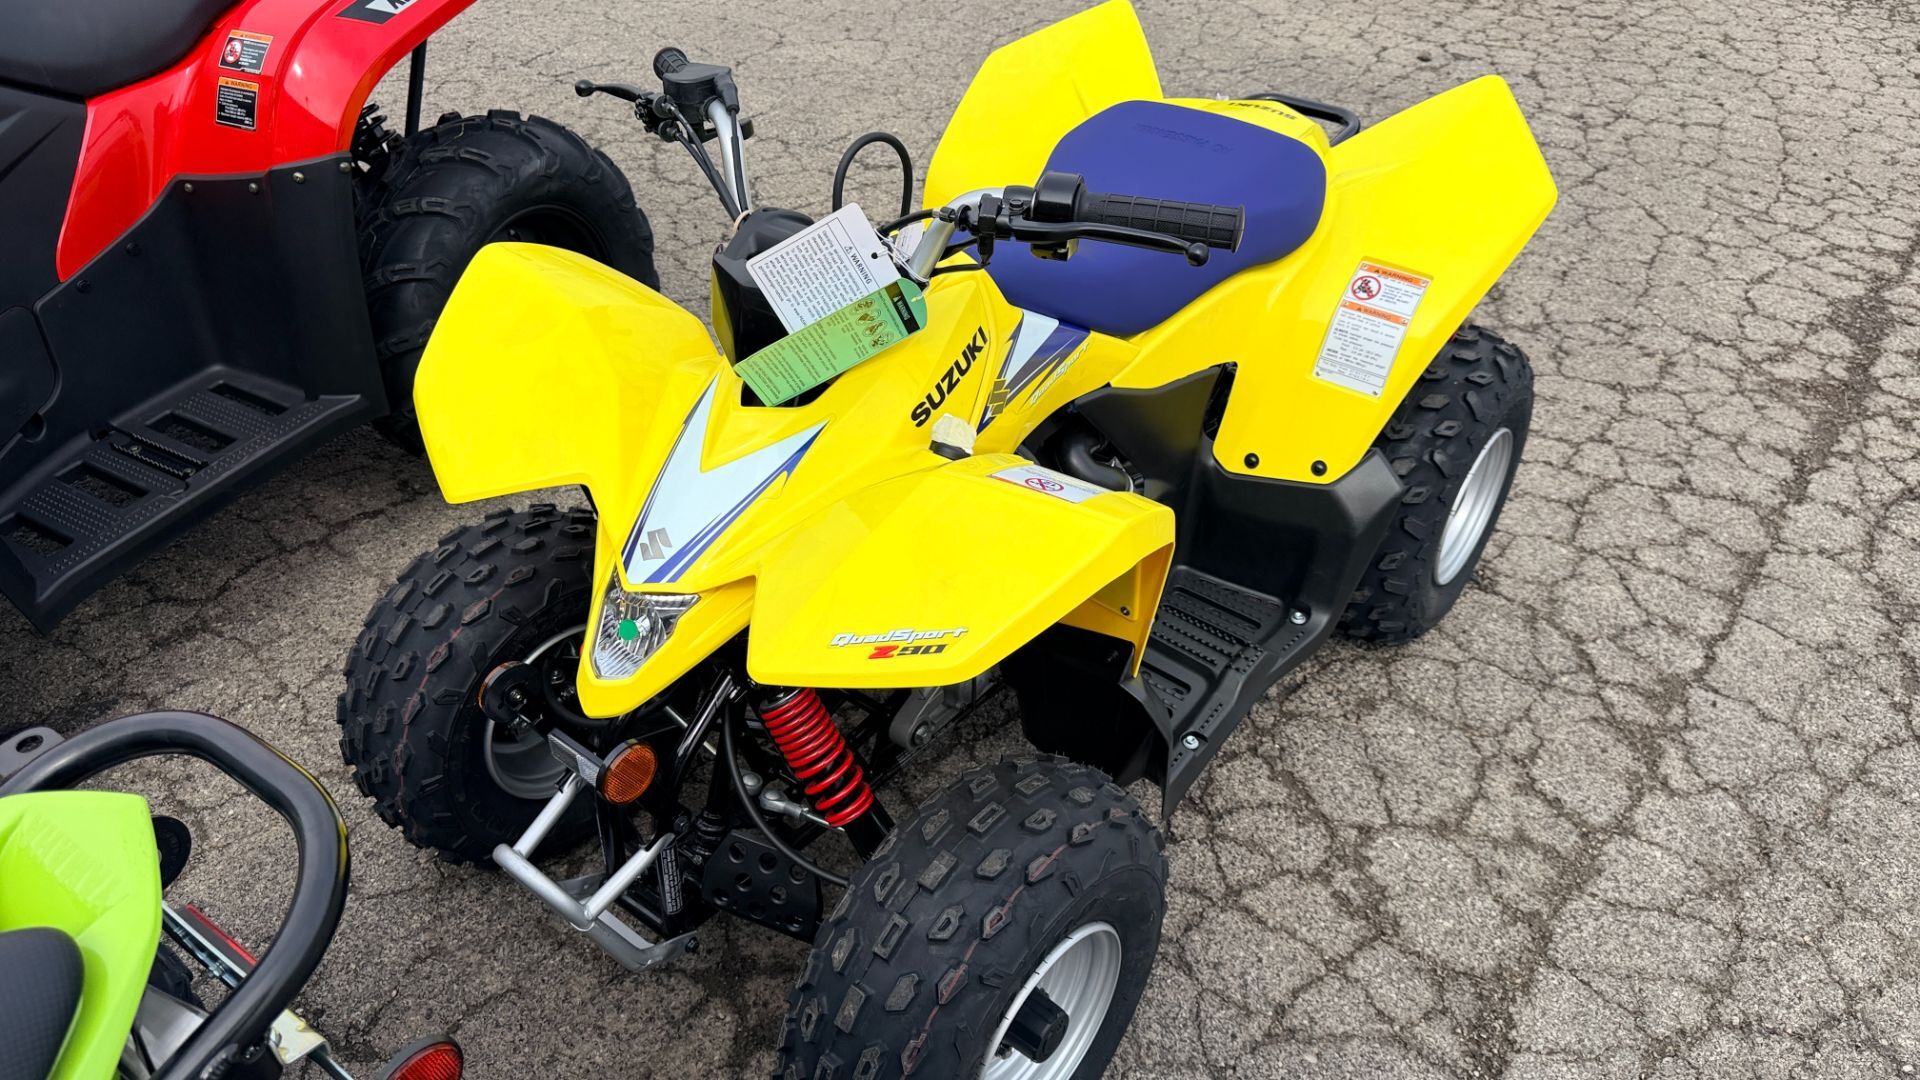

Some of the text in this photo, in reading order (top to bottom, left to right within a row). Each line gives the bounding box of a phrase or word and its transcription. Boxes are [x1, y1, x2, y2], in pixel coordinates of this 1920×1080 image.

[849, 253, 872, 284] WARNING
[911, 325, 988, 428] SUZUKI
[830, 627, 969, 647] QuadSport
[868, 644, 948, 660] Z90
